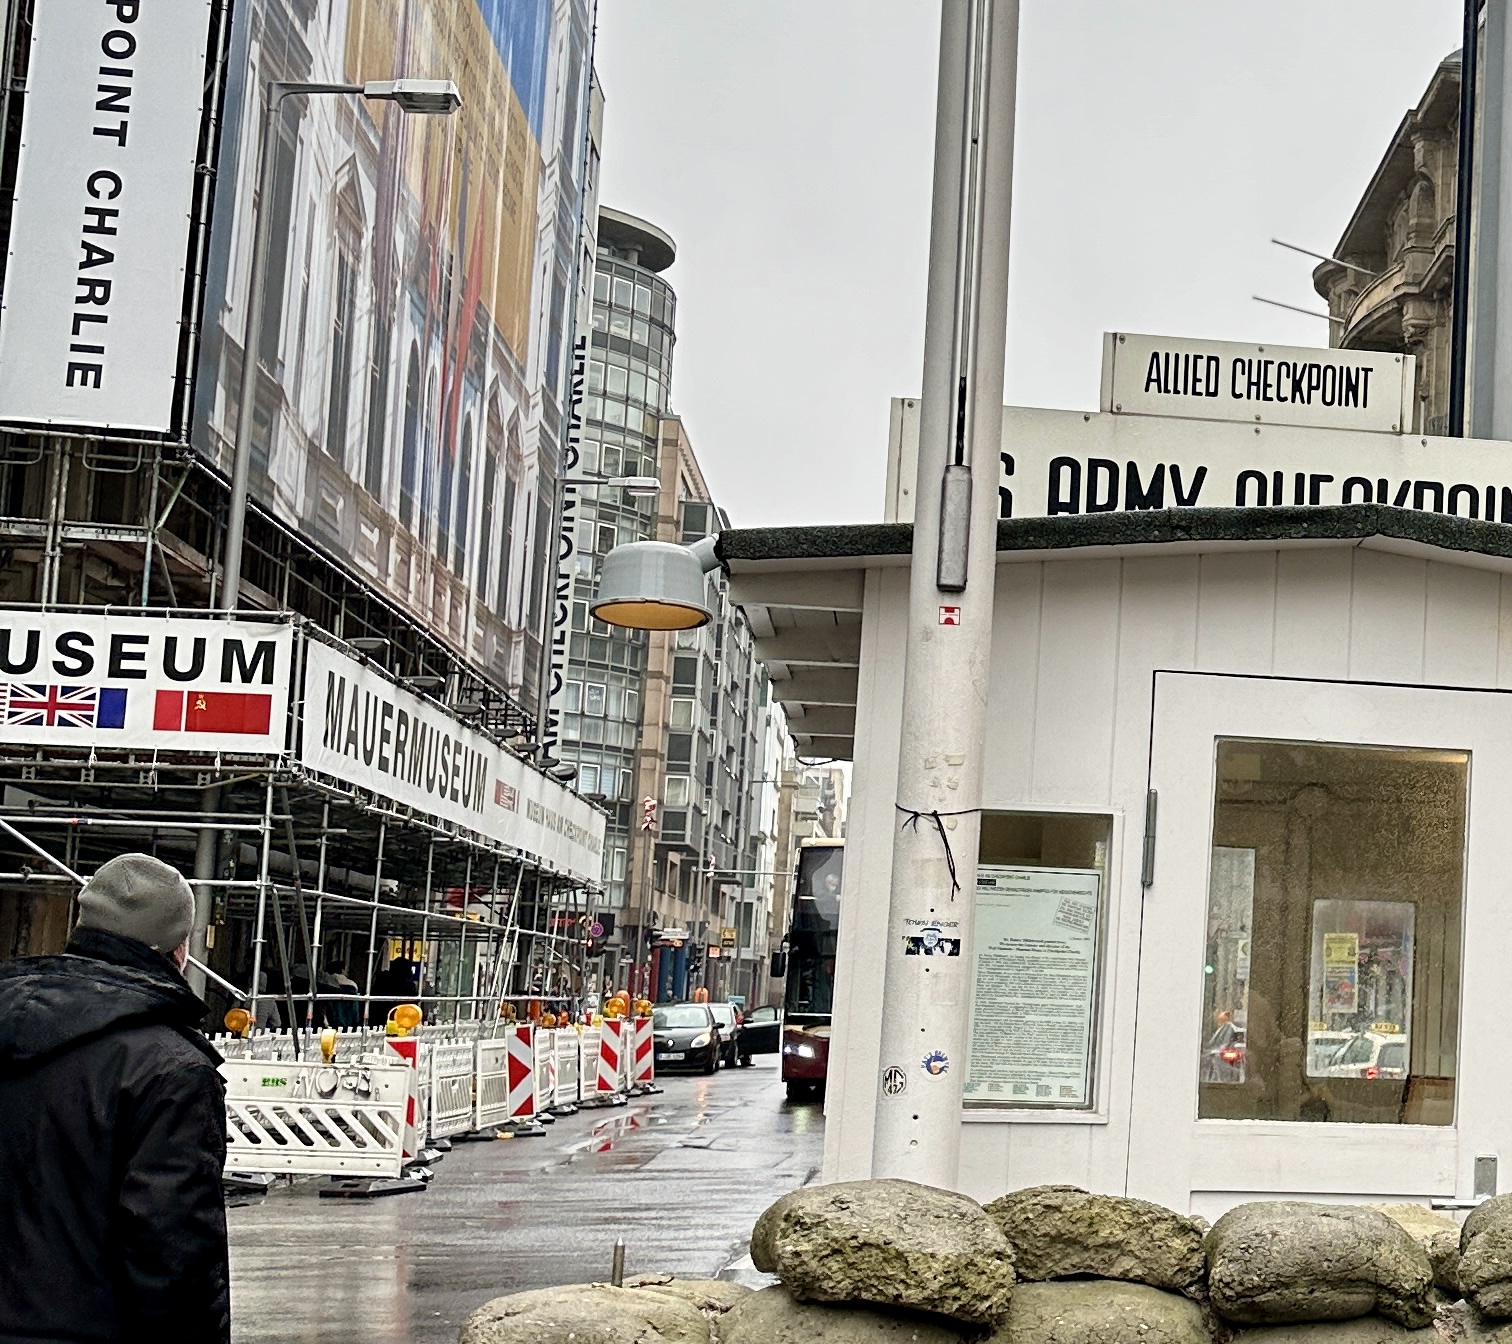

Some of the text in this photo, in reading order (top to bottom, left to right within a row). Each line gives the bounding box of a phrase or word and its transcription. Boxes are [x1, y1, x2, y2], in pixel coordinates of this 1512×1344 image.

[65, 170, 122, 390] CHARLIE
[1145, 350, 1375, 409] ALLIED CHECKPOINT
[0, 628, 277, 685] USEUM
[323, 670, 490, 815] MAUERMUSEUM
